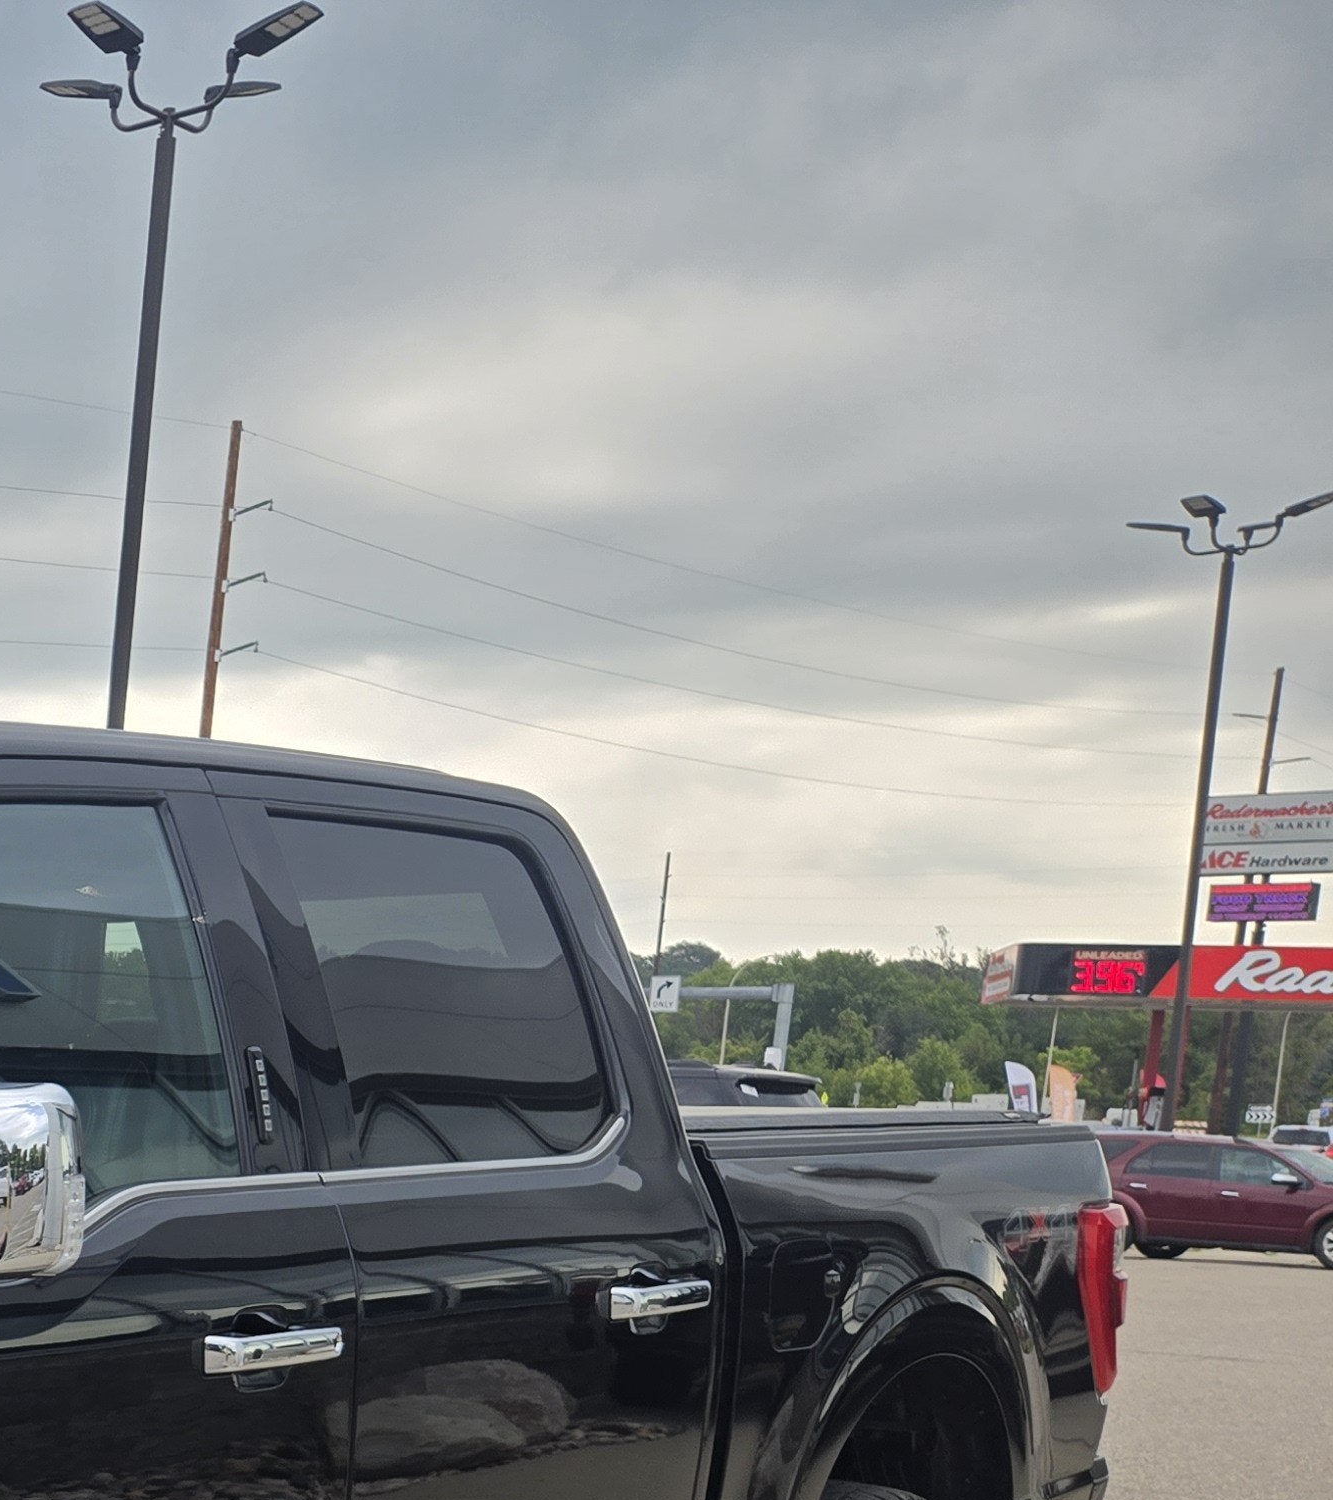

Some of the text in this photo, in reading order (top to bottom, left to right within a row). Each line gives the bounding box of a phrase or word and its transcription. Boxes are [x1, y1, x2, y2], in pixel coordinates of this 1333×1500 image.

[1274, 821, 1330, 830] MARKET
[1199, 850, 1328, 868] ACE Hardware
